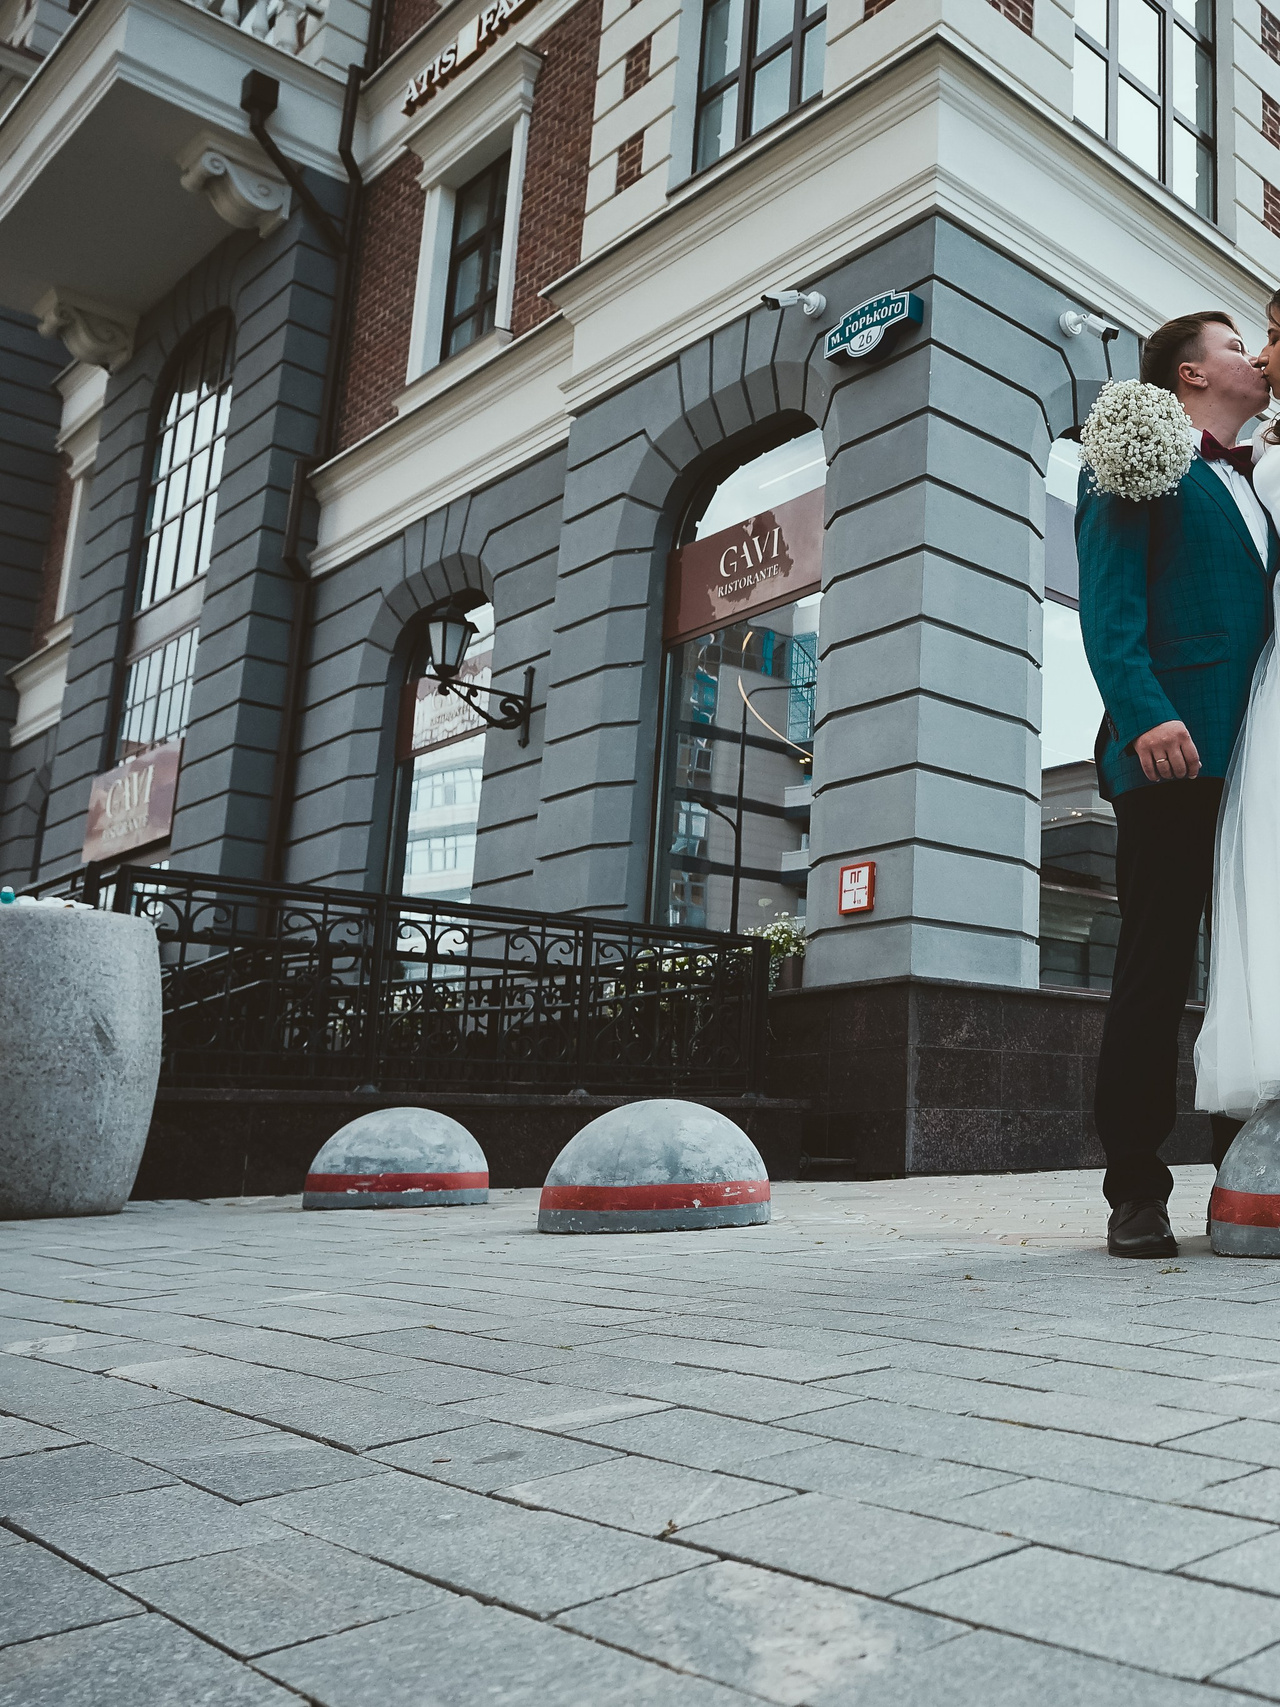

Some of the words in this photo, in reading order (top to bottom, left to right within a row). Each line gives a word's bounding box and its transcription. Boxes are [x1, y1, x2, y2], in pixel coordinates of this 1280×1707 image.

[402, 42, 458, 109] ATIS
[479, 0, 526, 42] FA
[830, 333, 843, 347] М.
[845, 301, 902, 337] ГОРЬКОГО
[858, 329, 873, 349] 26
[719, 526, 781, 578] GAVI
[717, 563, 779, 598] RISTORANTE
[106, 764, 154, 819] GAVI
[850, 870, 862, 884] ПГ
